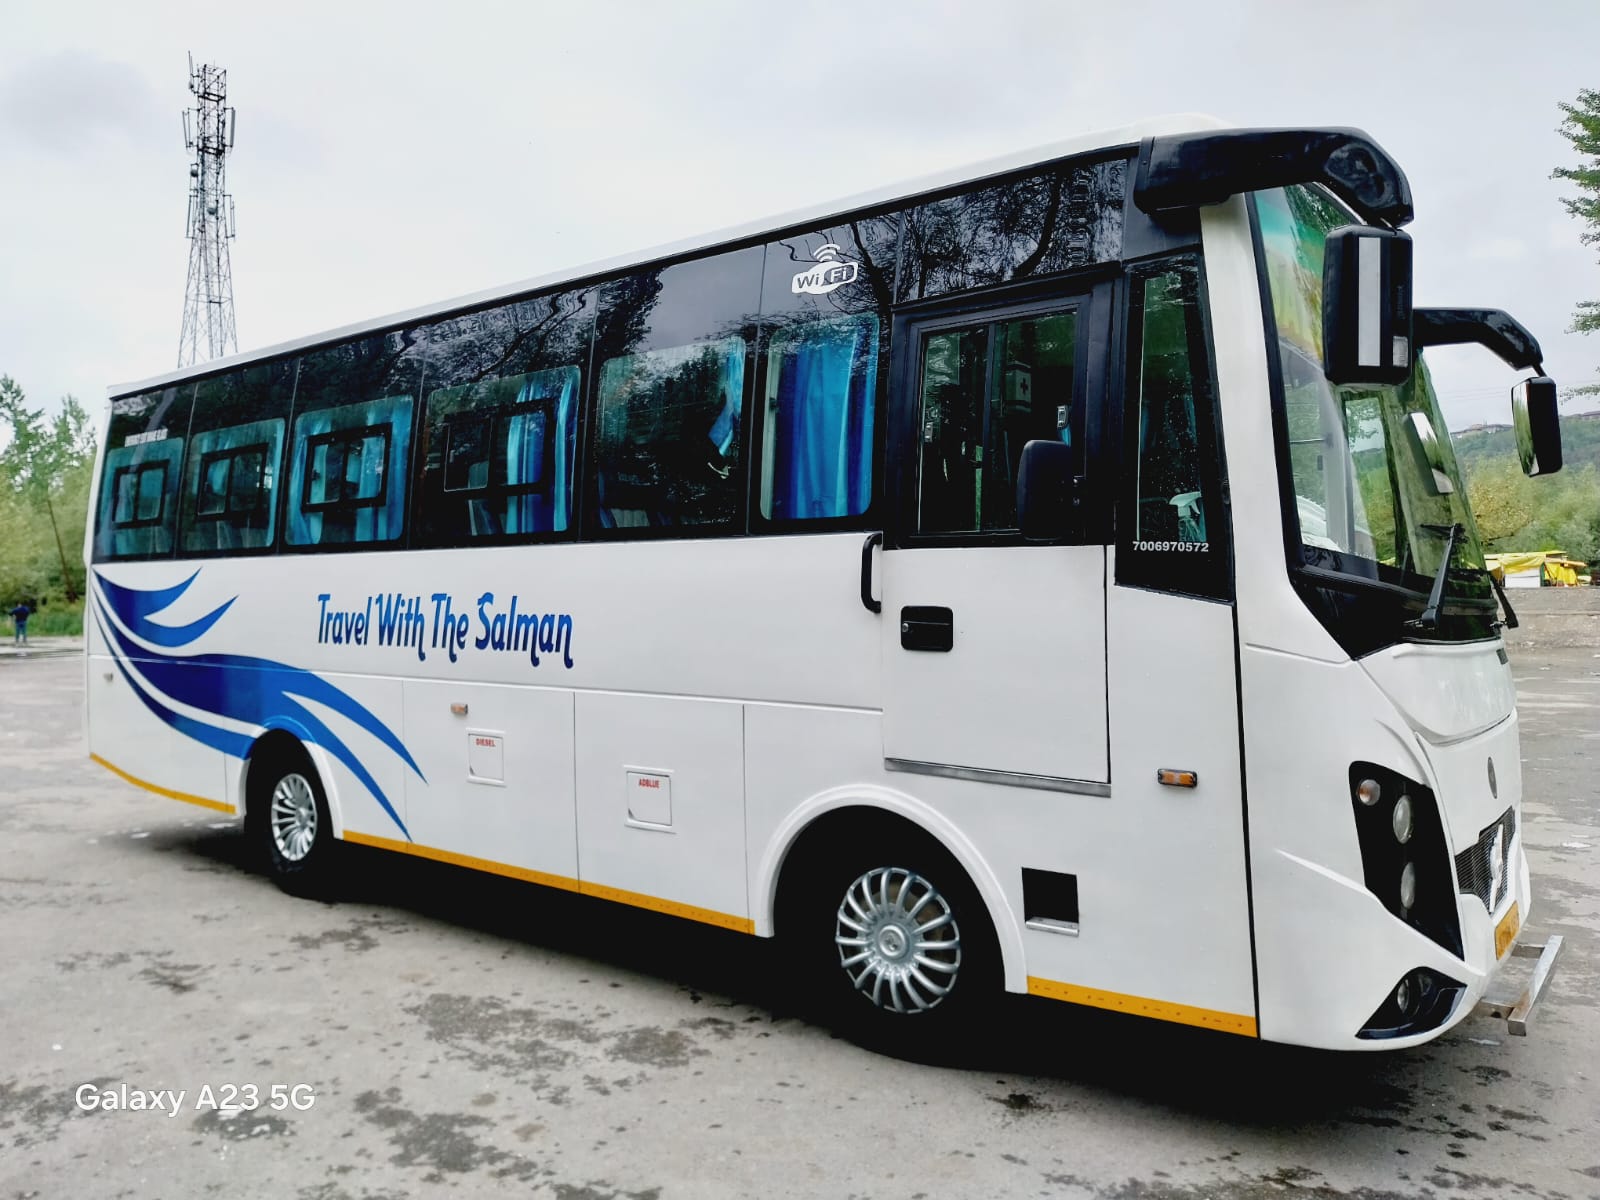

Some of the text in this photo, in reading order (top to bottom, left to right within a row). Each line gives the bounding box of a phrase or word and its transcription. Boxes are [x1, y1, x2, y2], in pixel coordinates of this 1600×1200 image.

[1132, 541, 1209, 552] 7006970572
[317, 592, 574, 669] Travel With The Salman
[475, 737, 496, 748] DIESEL
